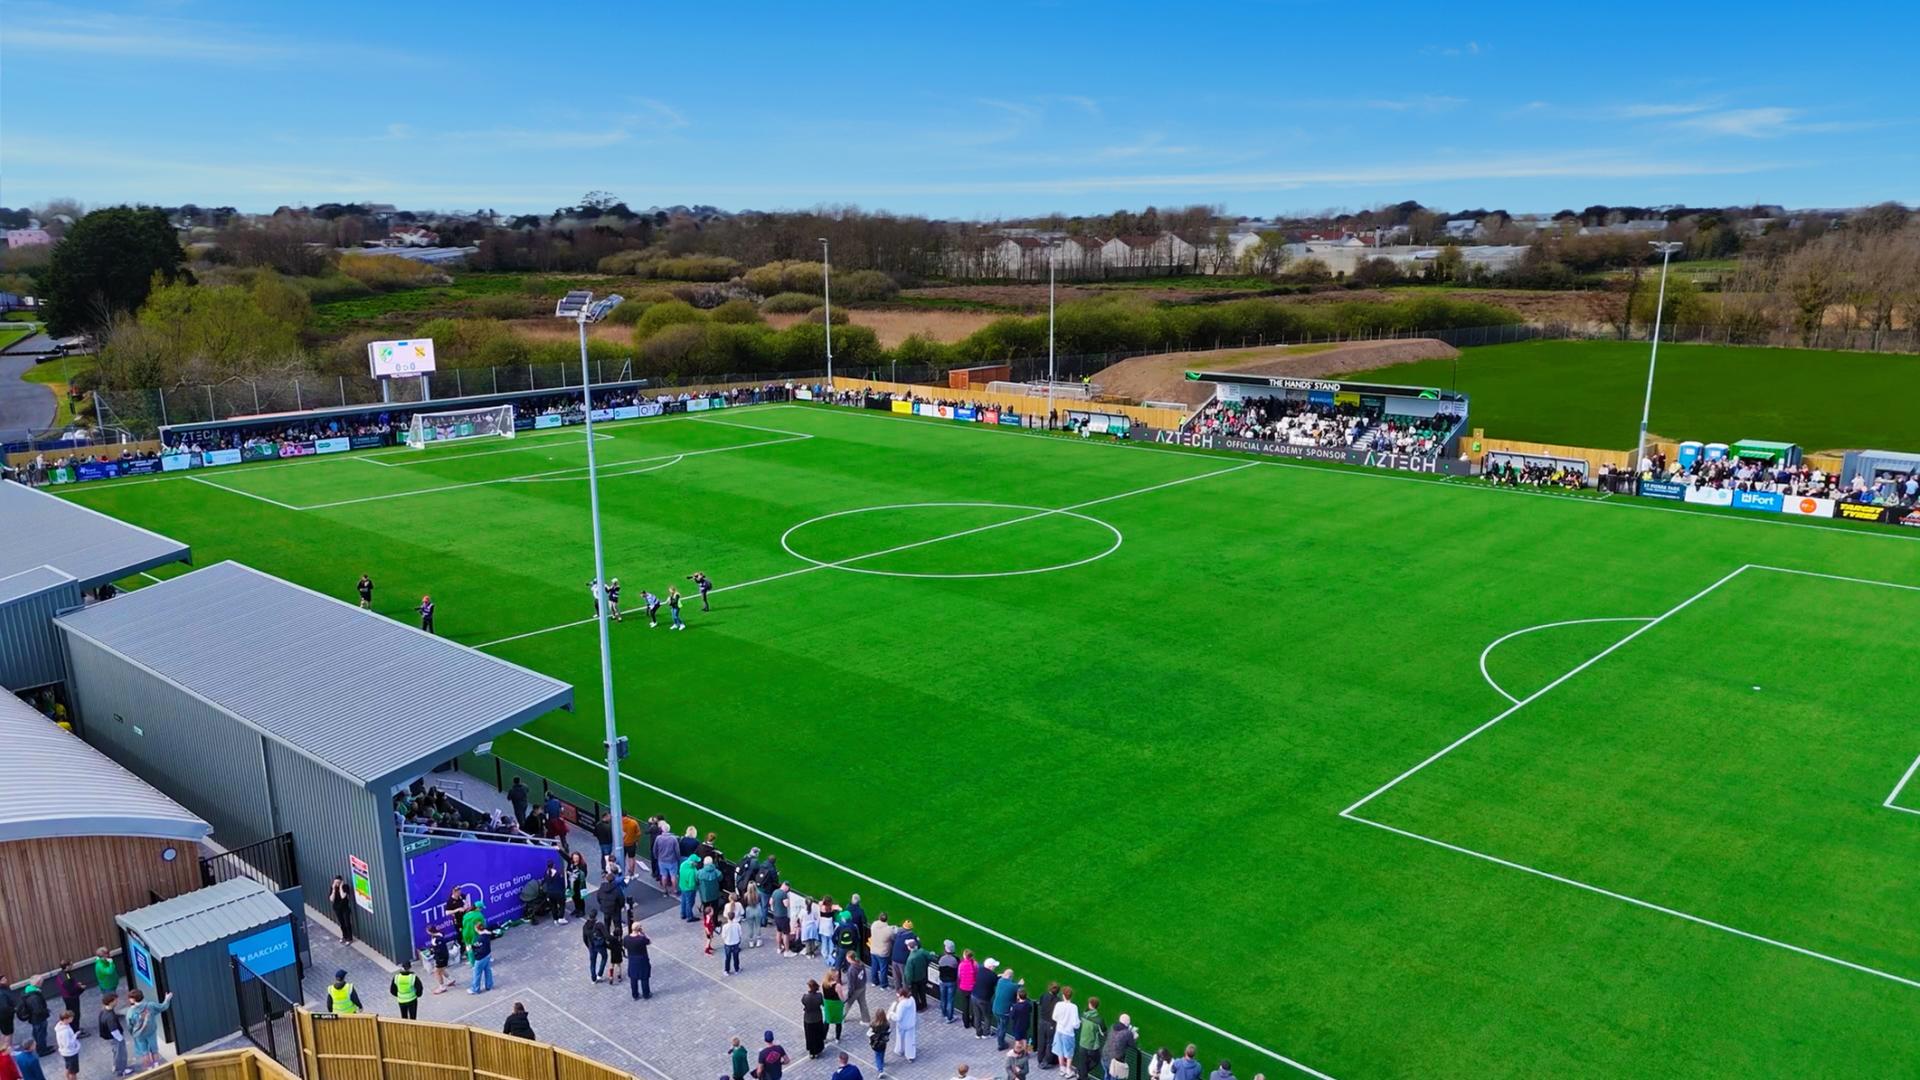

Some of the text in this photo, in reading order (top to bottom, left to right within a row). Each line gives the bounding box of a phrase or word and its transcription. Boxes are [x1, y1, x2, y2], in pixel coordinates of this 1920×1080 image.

[1269, 379, 1283, 387] THE
[1314, 383, 1341, 391] STAND
[1155, 430, 1436, 473] AZTECH OFFICIAL ACADEMY SPONSOR AZTECH
[1752, 494, 1775, 506] Fort
[489, 873, 531, 894] Extra time
[490, 893, 503, 904] for
[247, 941, 288, 961] BARCLAYS
